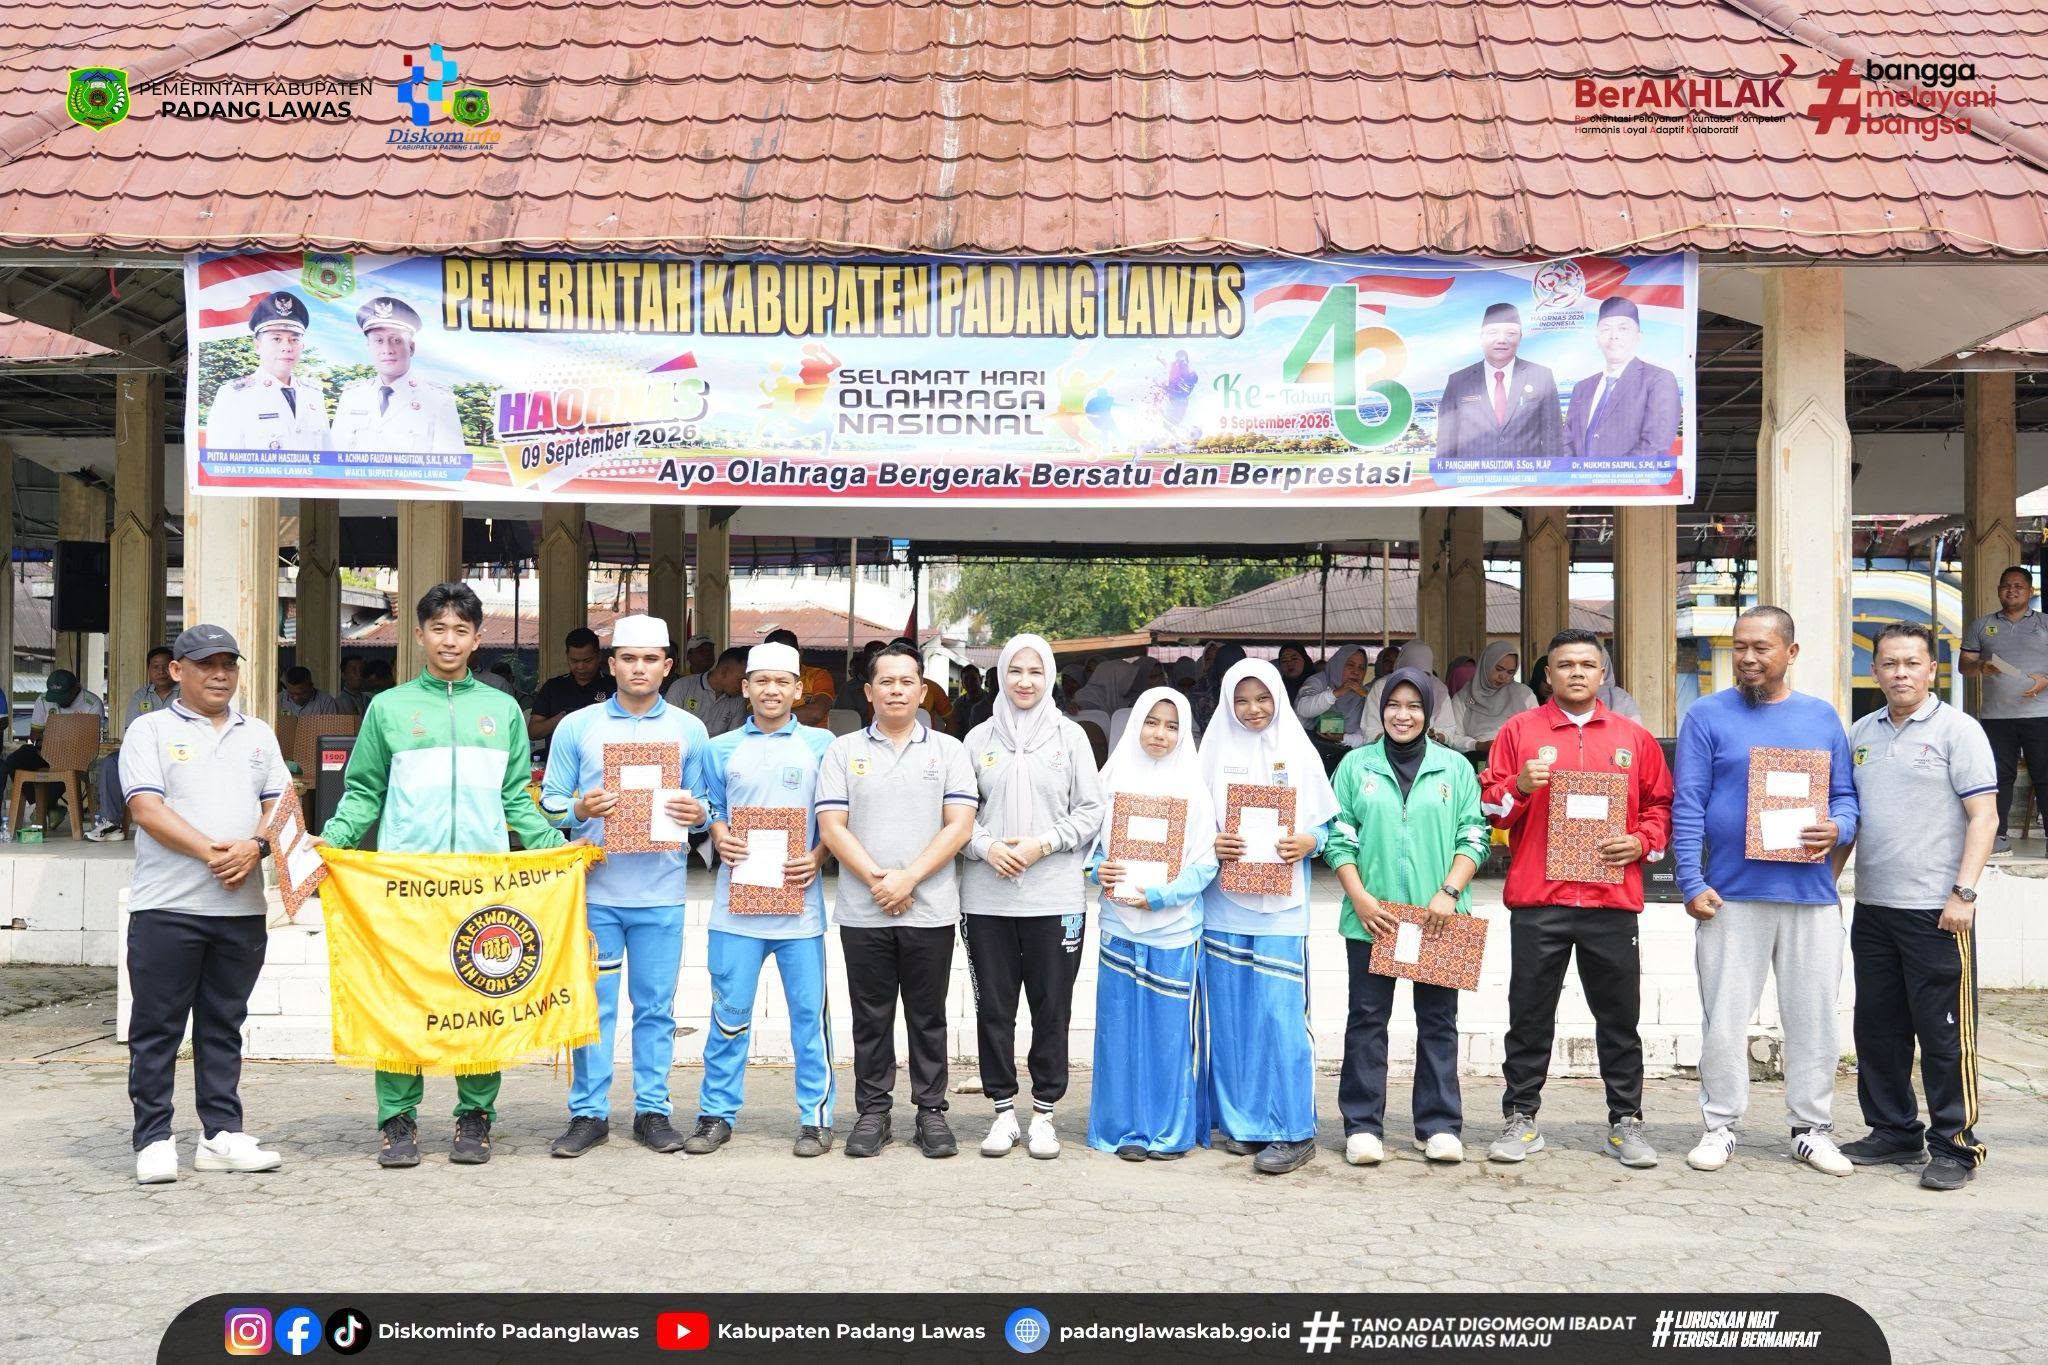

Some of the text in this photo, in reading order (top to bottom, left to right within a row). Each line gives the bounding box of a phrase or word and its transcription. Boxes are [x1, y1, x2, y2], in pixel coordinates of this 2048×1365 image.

[443, 257, 1245, 338] PEMERINTAH KABUPATEN PADANG LAWAS
[839, 369, 1045, 386] SELAMAT HARI
[839, 388, 1045, 410] OLAHRAGA
[1280, 388, 1333, 406] Tahun
[839, 413, 1044, 435] NASIONAL
[1219, 414, 1330, 433] 9 September 2026
[207, 451, 228, 462] PUTRA
[260, 452, 279, 463] ALAM
[312, 453, 321, 464] SE
[521, 424, 697, 470] 09 September 2026
[214, 465, 313, 475] BUPATI PADANG LAWAS
[658, 459, 1412, 491] Ayo Olahraga Bergerak Bersatu dan Berprestasi
[386, 878, 483, 898] PENGURUS
[456, 908, 536, 954] TAEKWONDO
[458, 953, 537, 992] INDONESIA
[427, 988, 571, 1032] PADANG LAWAS
